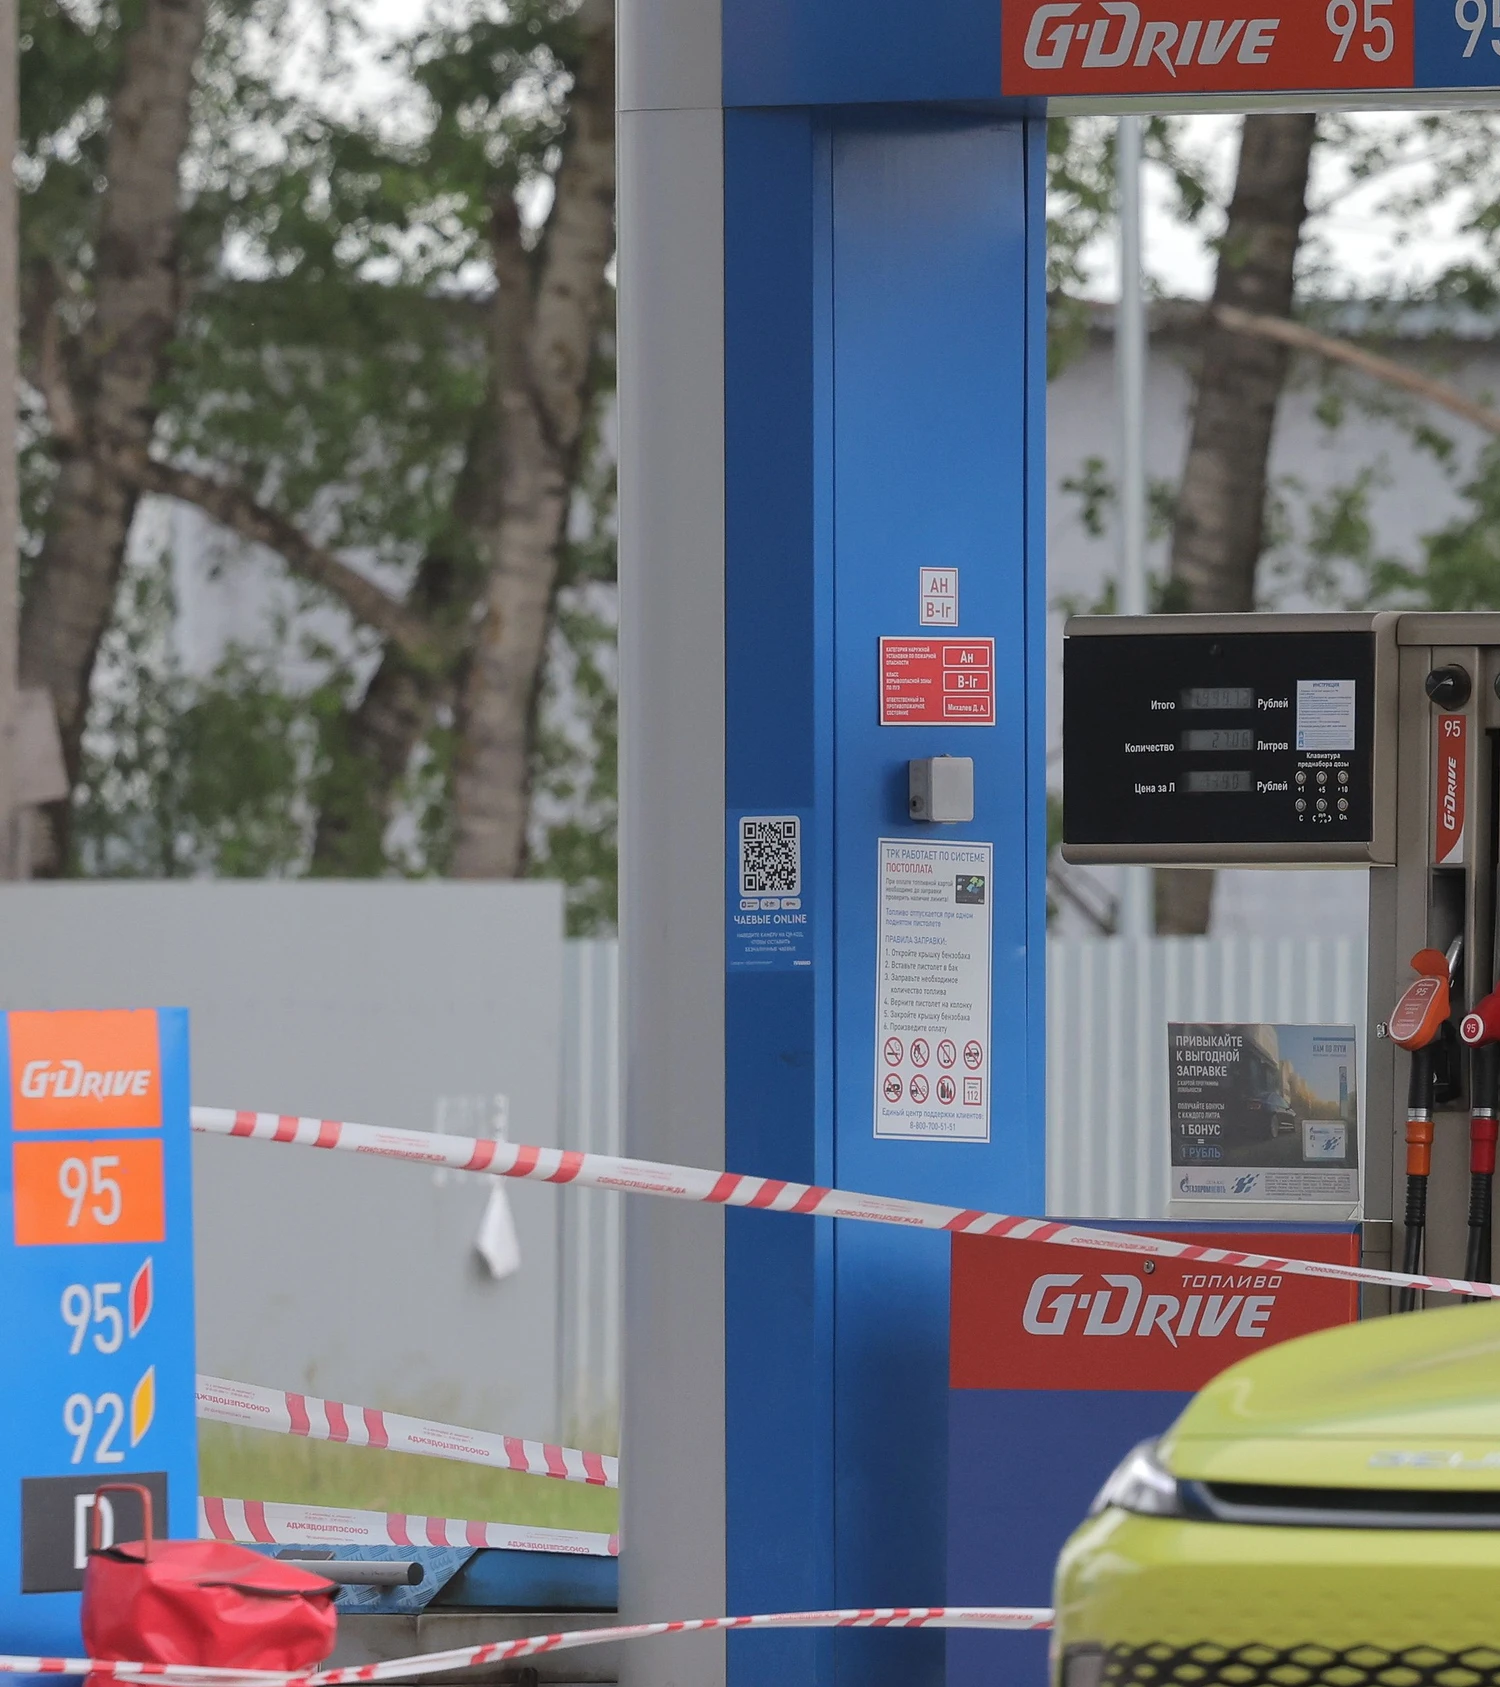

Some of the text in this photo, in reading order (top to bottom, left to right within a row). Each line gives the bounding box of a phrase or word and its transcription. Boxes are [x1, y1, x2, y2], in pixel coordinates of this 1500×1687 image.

[1325, 0, 1394, 62] 95
[1151, 699, 1176, 711] Итого
[1257, 697, 1289, 710] Рублей
[1444, 720, 1461, 738] 95
[1125, 742, 1174, 753] Количество
[1257, 740, 1289, 752] Литров
[1134, 782, 1175, 795] Цена за Л
[1257, 780, 1288, 792] Рублей
[886, 849, 985, 862] ТРК РАБОТАЕТ ПО СИСТЕМЕ
[886, 863, 933, 874] ПОСТОПЛАТА
[886, 908, 909, 916] Топливо
[734, 914, 807, 924] ЧАЕВЫЕ ONLINE
[885, 935, 912, 944] ПРАВИЛА
[892, 948, 917, 958] Откройте
[918, 950, 940, 960] крышку
[941, 951, 970, 960] бензобака
[891, 961, 916, 969] Вставьте
[917, 963, 942, 971] пистолет
[891, 973, 920, 982] Заправьте
[941, 1012, 970, 1021] бензобака
[890, 1023, 927, 1032] Произведите
[1466, 1024, 1476, 1033] 95
[1176, 1034, 1243, 1047] ПРИВЫКАЙТЕ
[1177, 1049, 1240, 1063] К ВЫГОДНОЙ
[1177, 1066, 1227, 1076] ЗАПРАВКЕ
[967, 1091, 978, 1100] 112
[1181, 1124, 1220, 1135] 1 БОНУС
[1190, 1148, 1220, 1158] РУБЛЬ
[58, 1155, 123, 1228] 95
[1181, 1274, 1283, 1289] ТОПЛИВО
[60, 1282, 124, 1355] 95
[63, 1391, 126, 1465] 92
